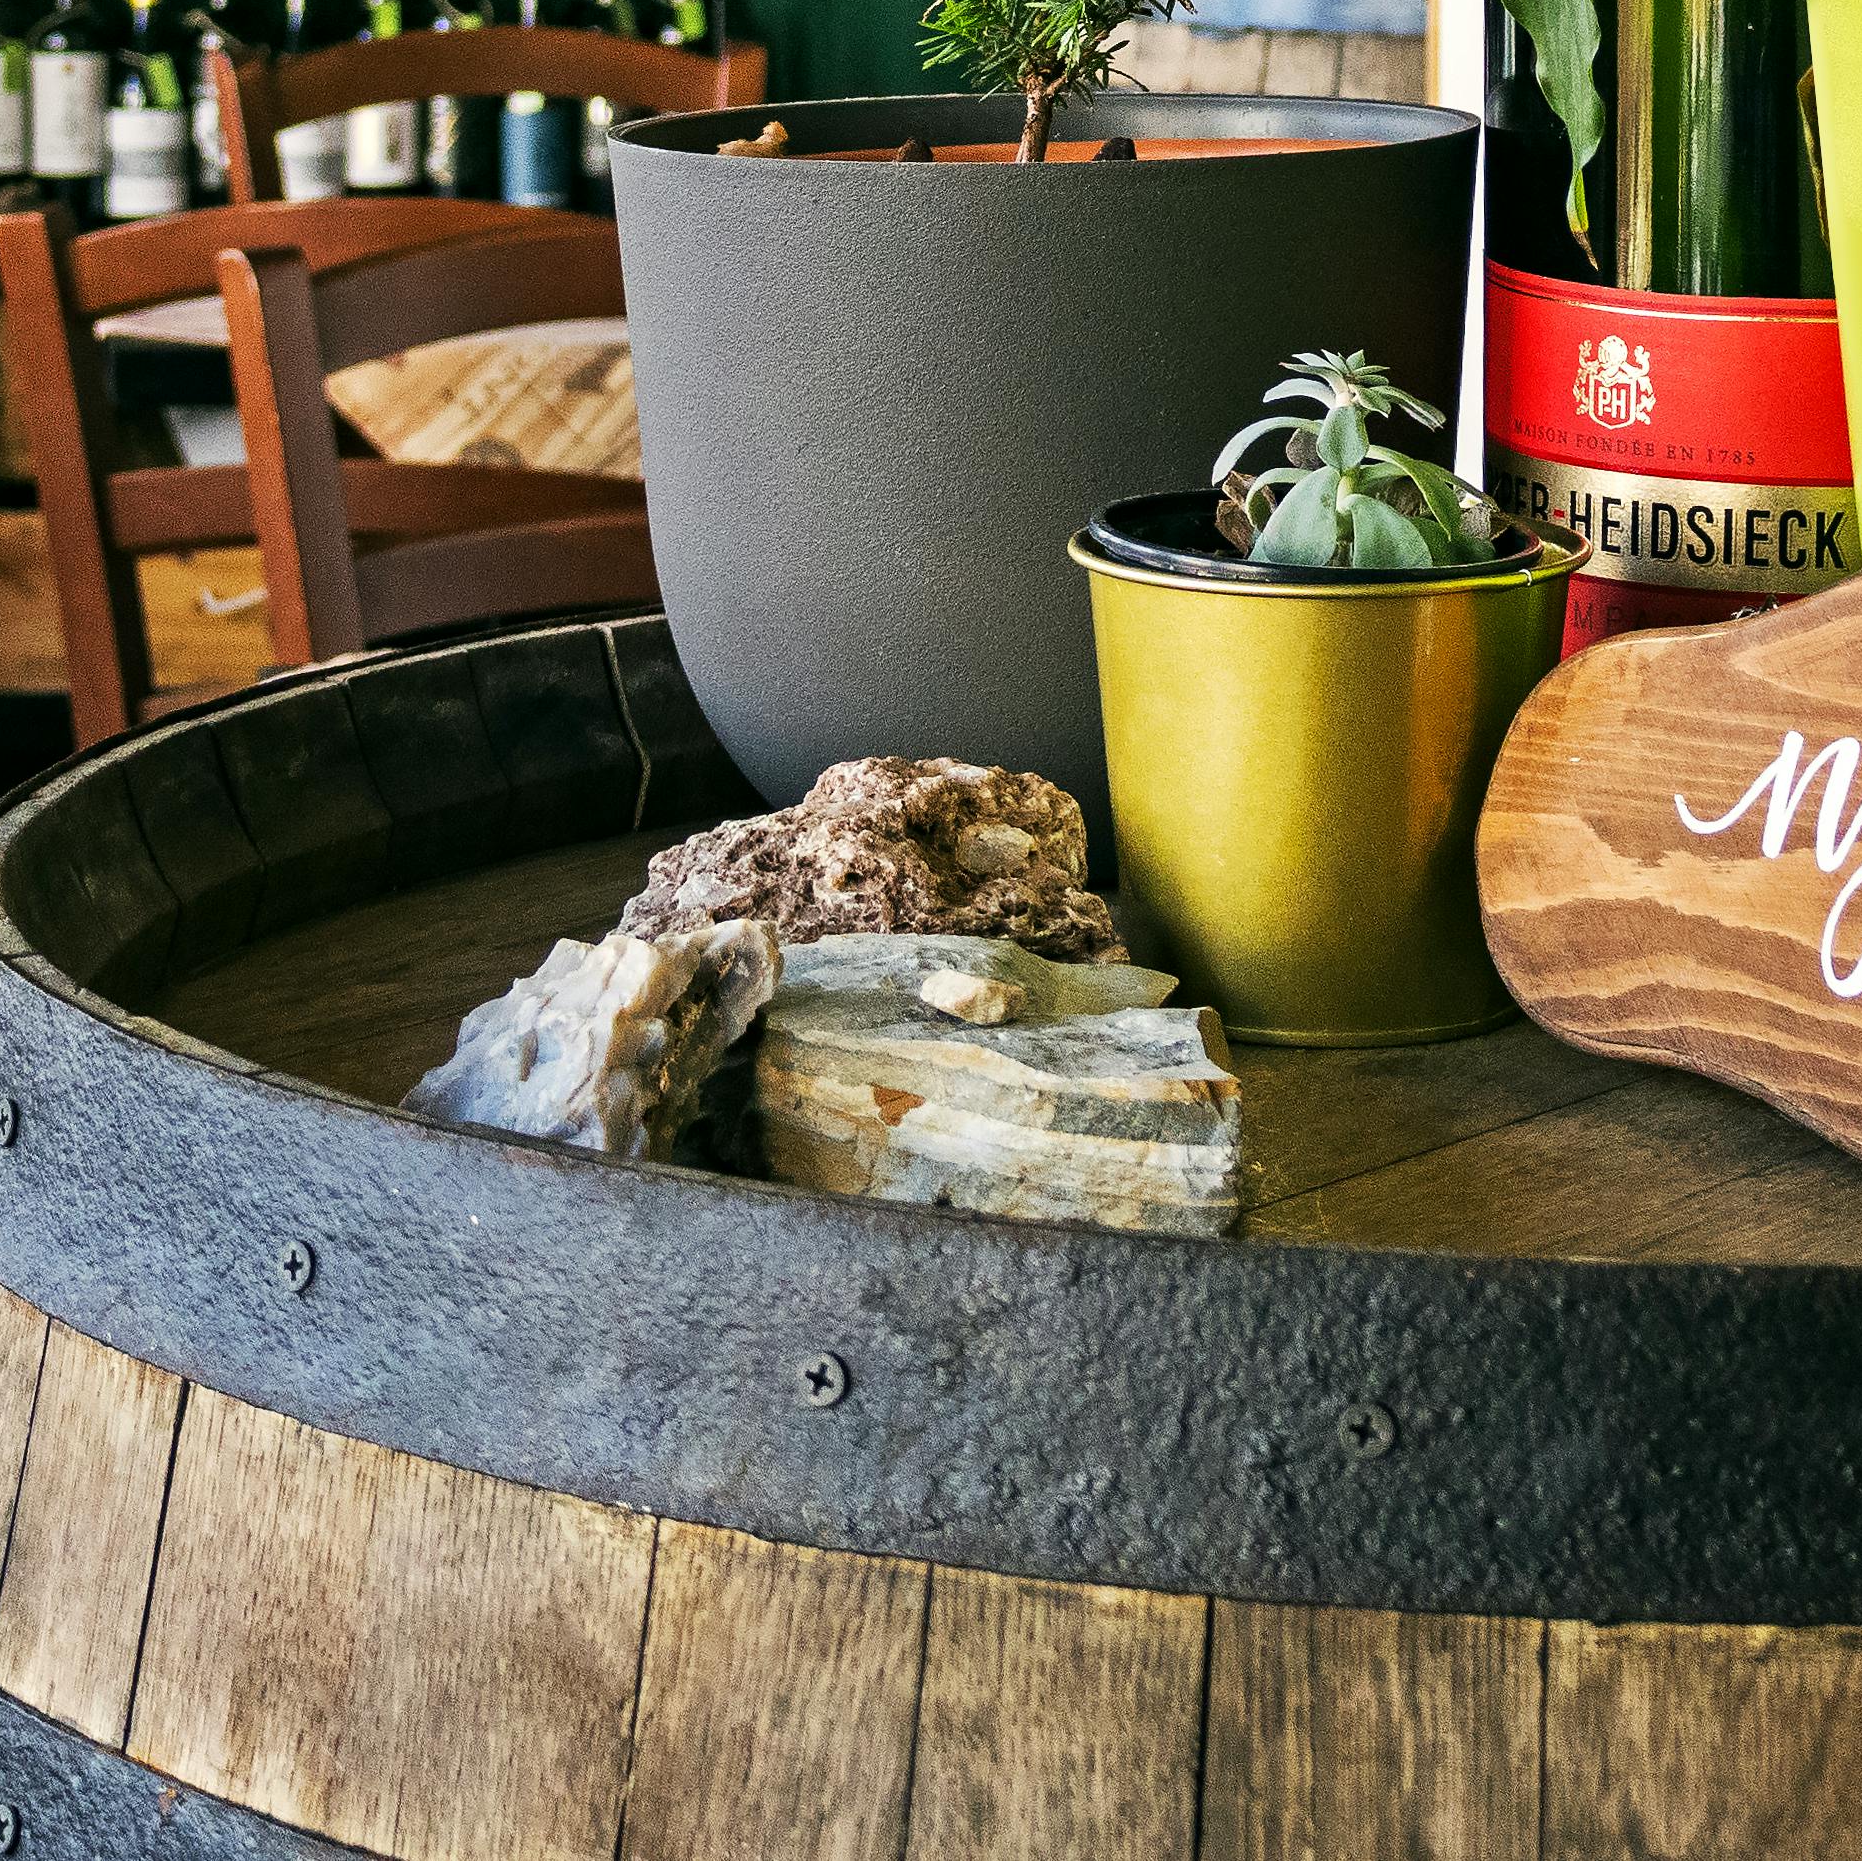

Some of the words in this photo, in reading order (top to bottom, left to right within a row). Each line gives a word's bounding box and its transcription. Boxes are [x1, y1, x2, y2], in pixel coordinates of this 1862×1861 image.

[1513, 419, 1568, 445] MAISON
[1666, 444, 1694, 461] EN
[1705, 447, 1757, 466] 1785
